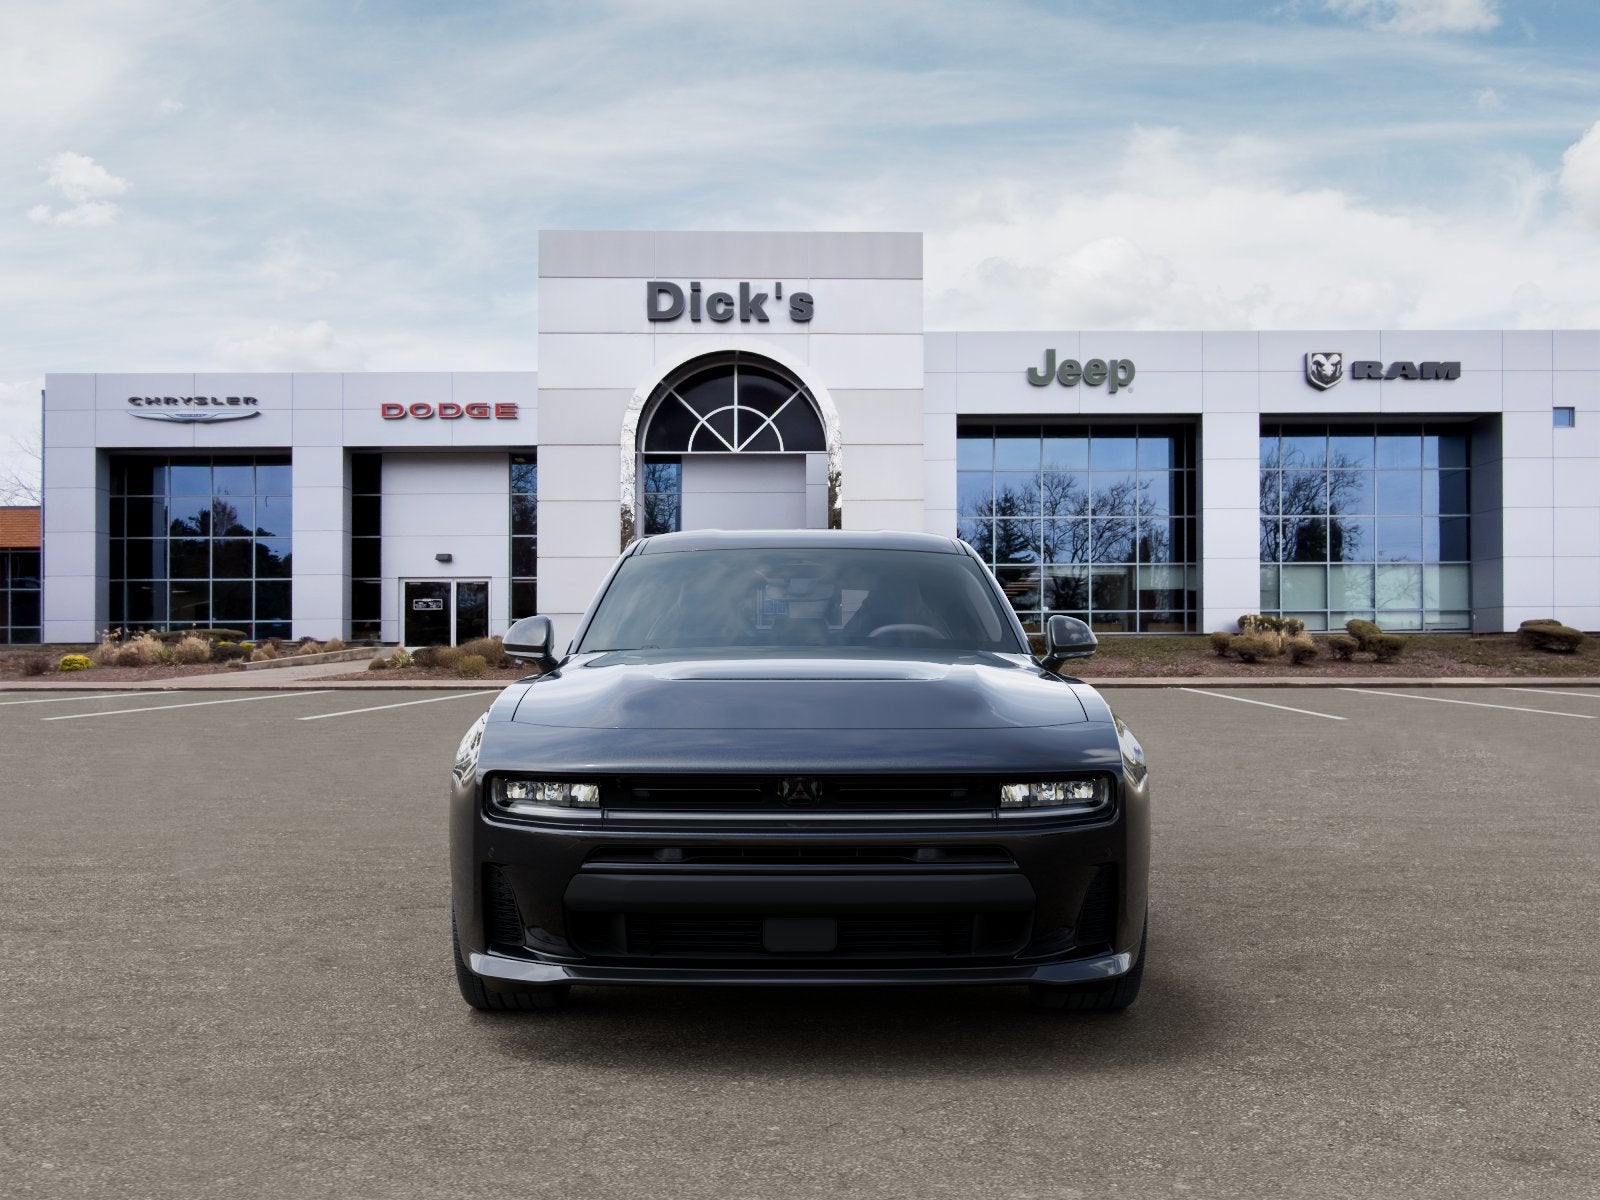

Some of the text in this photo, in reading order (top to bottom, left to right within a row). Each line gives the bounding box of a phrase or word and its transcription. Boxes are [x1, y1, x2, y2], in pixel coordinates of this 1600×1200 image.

[647, 281, 814, 322] Dick's
[1027, 348, 1136, 394] Jeep
[1352, 360, 1461, 380] RAM
[128, 396, 258, 407] CHRYSLER
[381, 402, 518, 420] DODGE
